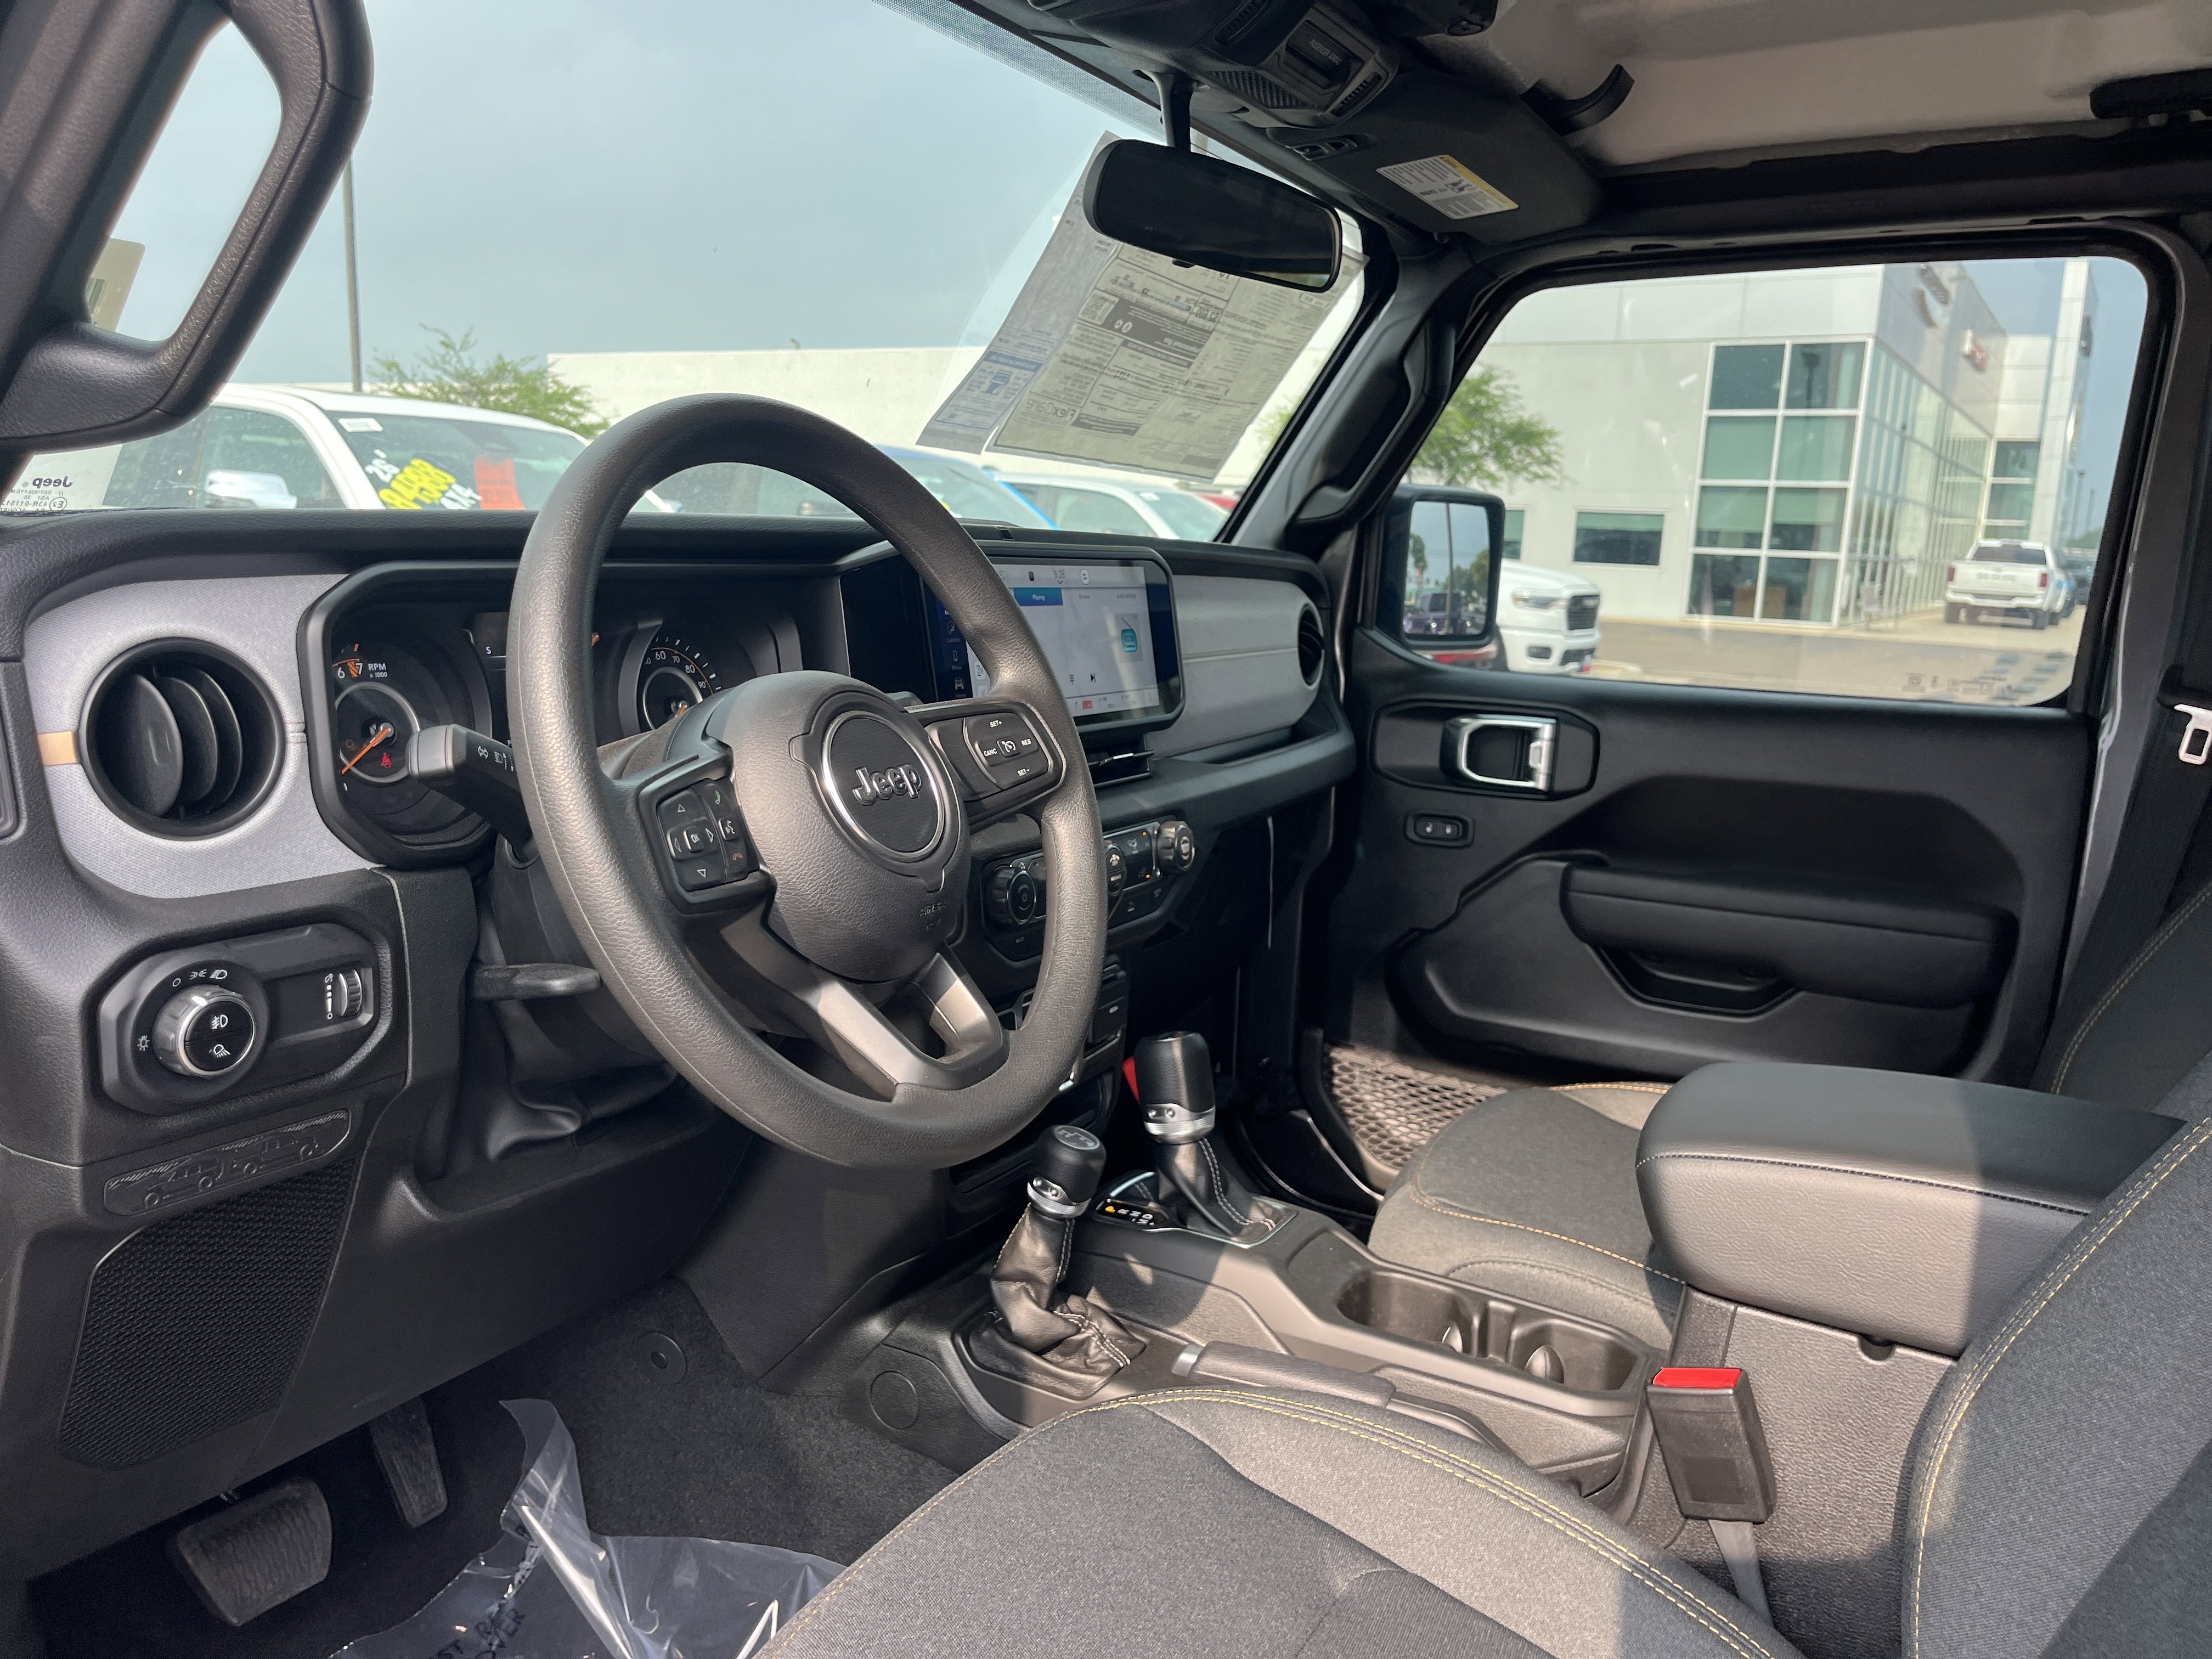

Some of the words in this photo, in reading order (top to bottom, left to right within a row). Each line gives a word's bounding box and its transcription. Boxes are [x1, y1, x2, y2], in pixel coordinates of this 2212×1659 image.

[486, 646, 492, 654] S
[655, 651, 666, 660] 60
[672, 655, 680, 663] 70
[337, 667, 346, 679] 6
[355, 662, 363, 675] 7
[368, 663, 387, 671] RPM
[685, 664, 695, 674] 80
[698, 681, 706, 689] 90
[983, 748, 997, 757] CANC
[853, 764, 922, 806] Jeep
[691, 833, 701, 843] OK
